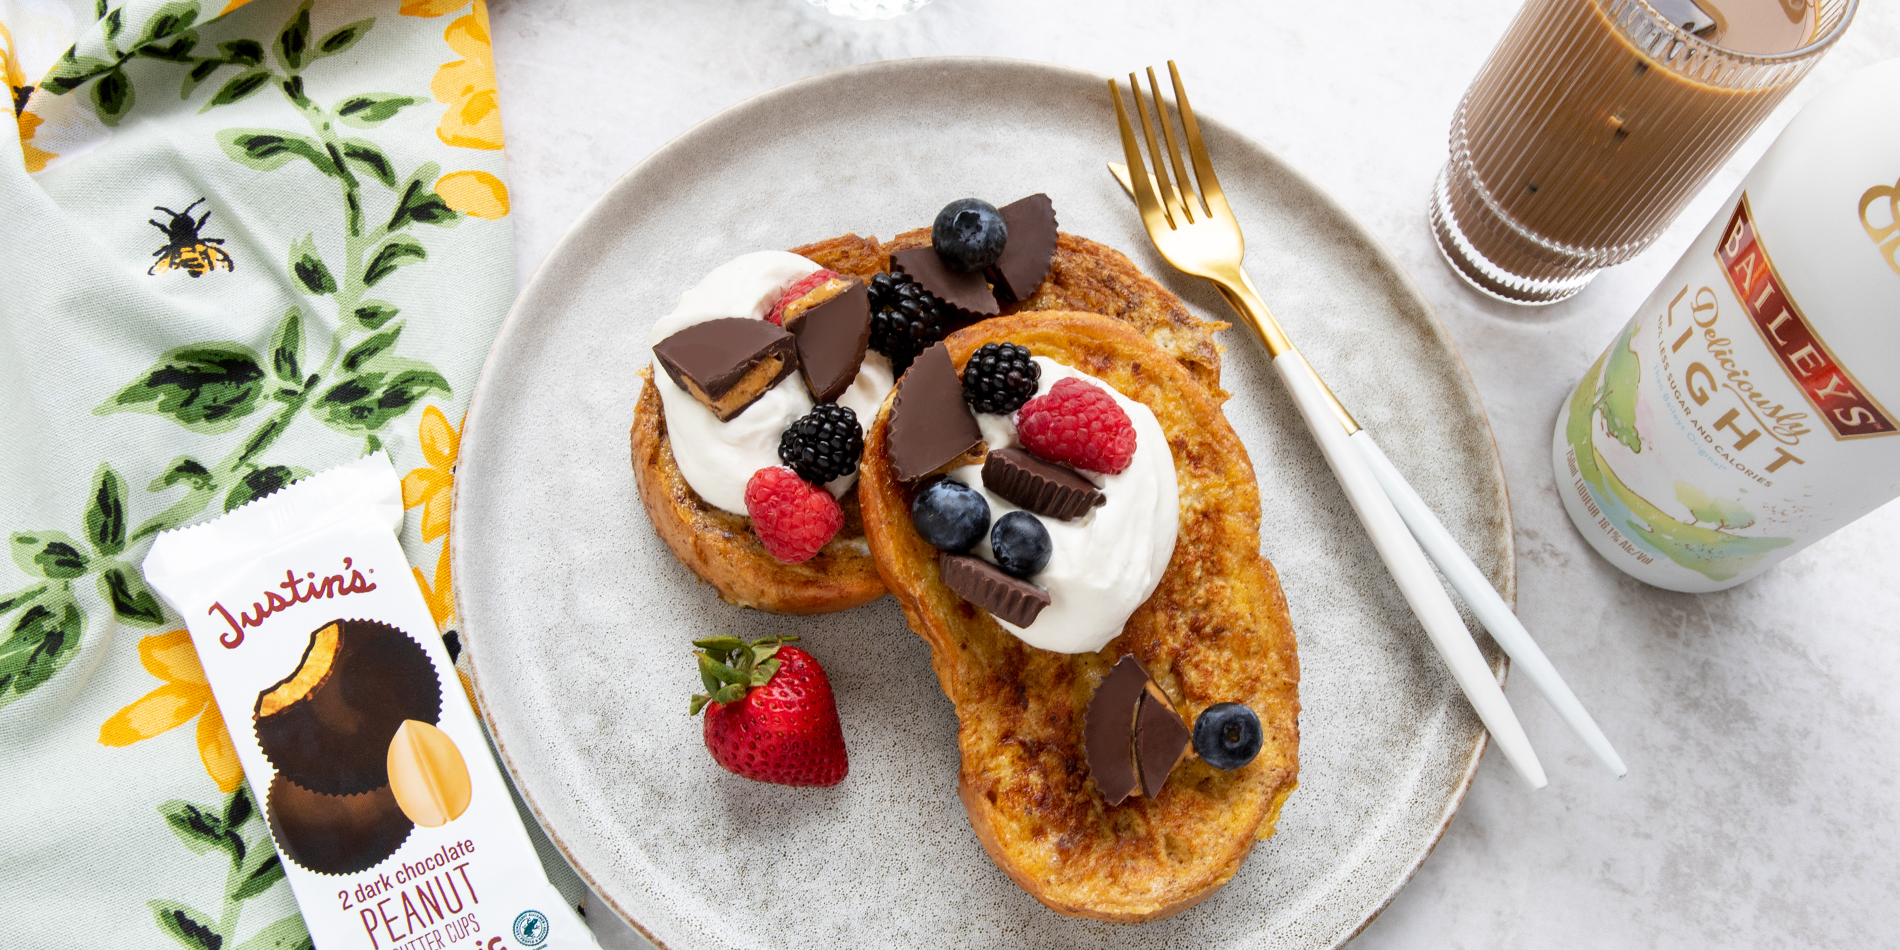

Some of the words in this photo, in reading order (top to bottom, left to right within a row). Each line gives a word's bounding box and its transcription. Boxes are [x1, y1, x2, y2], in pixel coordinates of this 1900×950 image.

[1690, 286, 1811, 445] Deliciously
[1725, 215, 1876, 427] BAILEYS
[1653, 363, 1664, 391] Than
[1662, 393, 1685, 431] Baileys
[1659, 341, 1670, 371] LESS
[1667, 373, 1692, 416] SUGAR
[1690, 419, 1713, 444] AND
[1714, 445, 1773, 487] CALORIES
[1667, 284, 1805, 474] LIGHT
[1566, 449, 1579, 477] 750ml
[1574, 478, 1600, 518] LIQUEUR
[1598, 517, 1622, 543] 16.1%
[1618, 541, 1654, 565] Alc/Vol
[208, 557, 377, 649] Justin's
[337, 890, 353, 911] 2
[354, 873, 394, 903] dark
[395, 839, 475, 885] chocolate
[359, 862, 479, 950] PEANUT
[445, 913, 481, 943] CUPS
